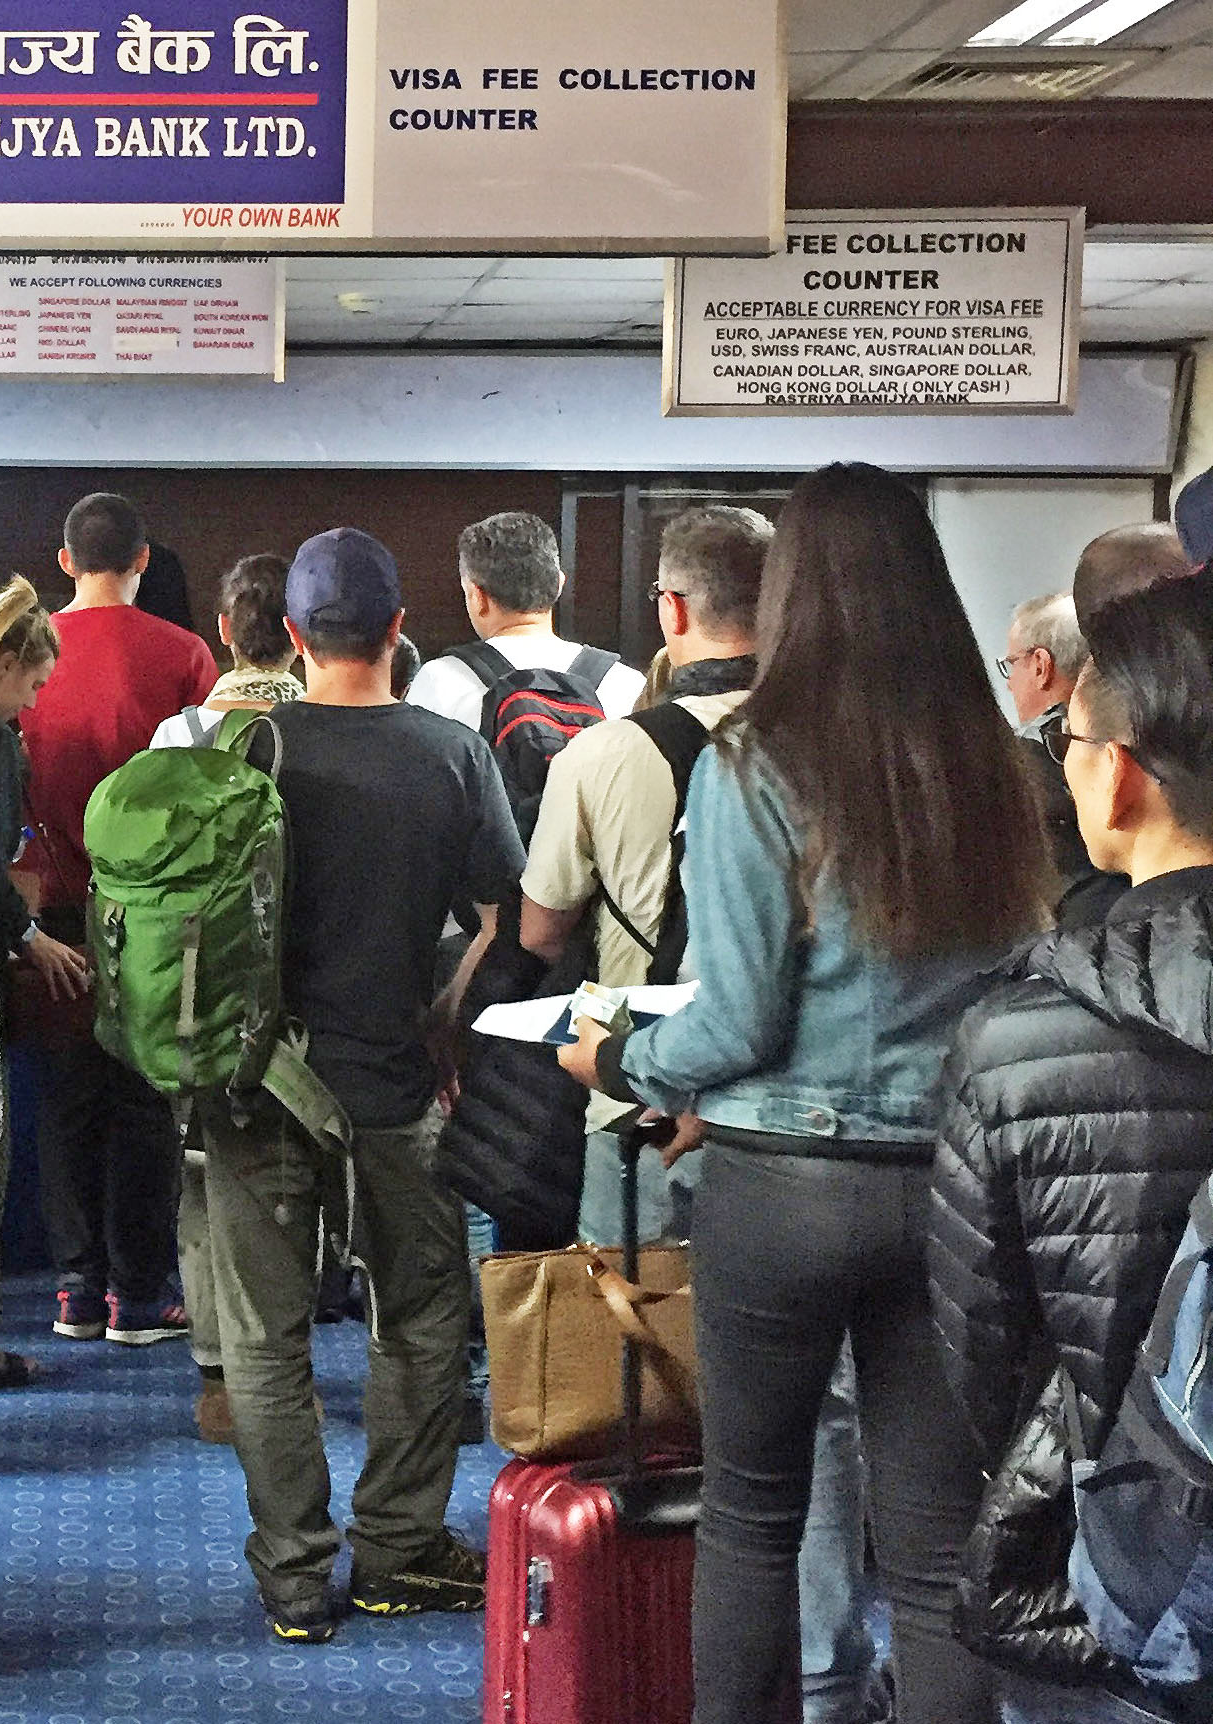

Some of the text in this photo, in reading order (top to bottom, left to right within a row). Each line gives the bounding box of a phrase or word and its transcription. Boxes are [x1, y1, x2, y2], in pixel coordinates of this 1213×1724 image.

[117, 14, 214, 77] बैंक
[233, 15, 320, 77] लि.
[389, 68, 756, 90] VISA FEE COLLECTION
[389, 109, 538, 131] COUNTER
[95, 117, 210, 158] BANK
[224, 118, 317, 158] LTD.
[182, 208, 341, 228] YOUR OWN BANK
[787, 233, 1026, 255] FEE COLLECTION
[10, 278, 222, 288] WE ACCEPT FOLLOWING CURRENCIES
[803, 270, 940, 290] COUNTER
[704, 300, 1044, 318] ACCEPTABLE CURRENCY FOR VISA FEE
[715, 327, 1033, 342] EURO, JAPANESE YEN, POUND STERLING,
[711, 343, 1036, 358] USD, SWISS FRANC, AUSTRALIAN DOLLAR,
[713, 364, 1033, 378] CANADIAN DOLLAR, SINGAPORE DOLLAR,
[737, 381, 781, 395] HONG
[786, 381, 831, 395] KONG
[836, 381, 898, 395] DOLLAR
[912, 381, 953, 395] ONLY
[958, 381, 999, 395] CASH
